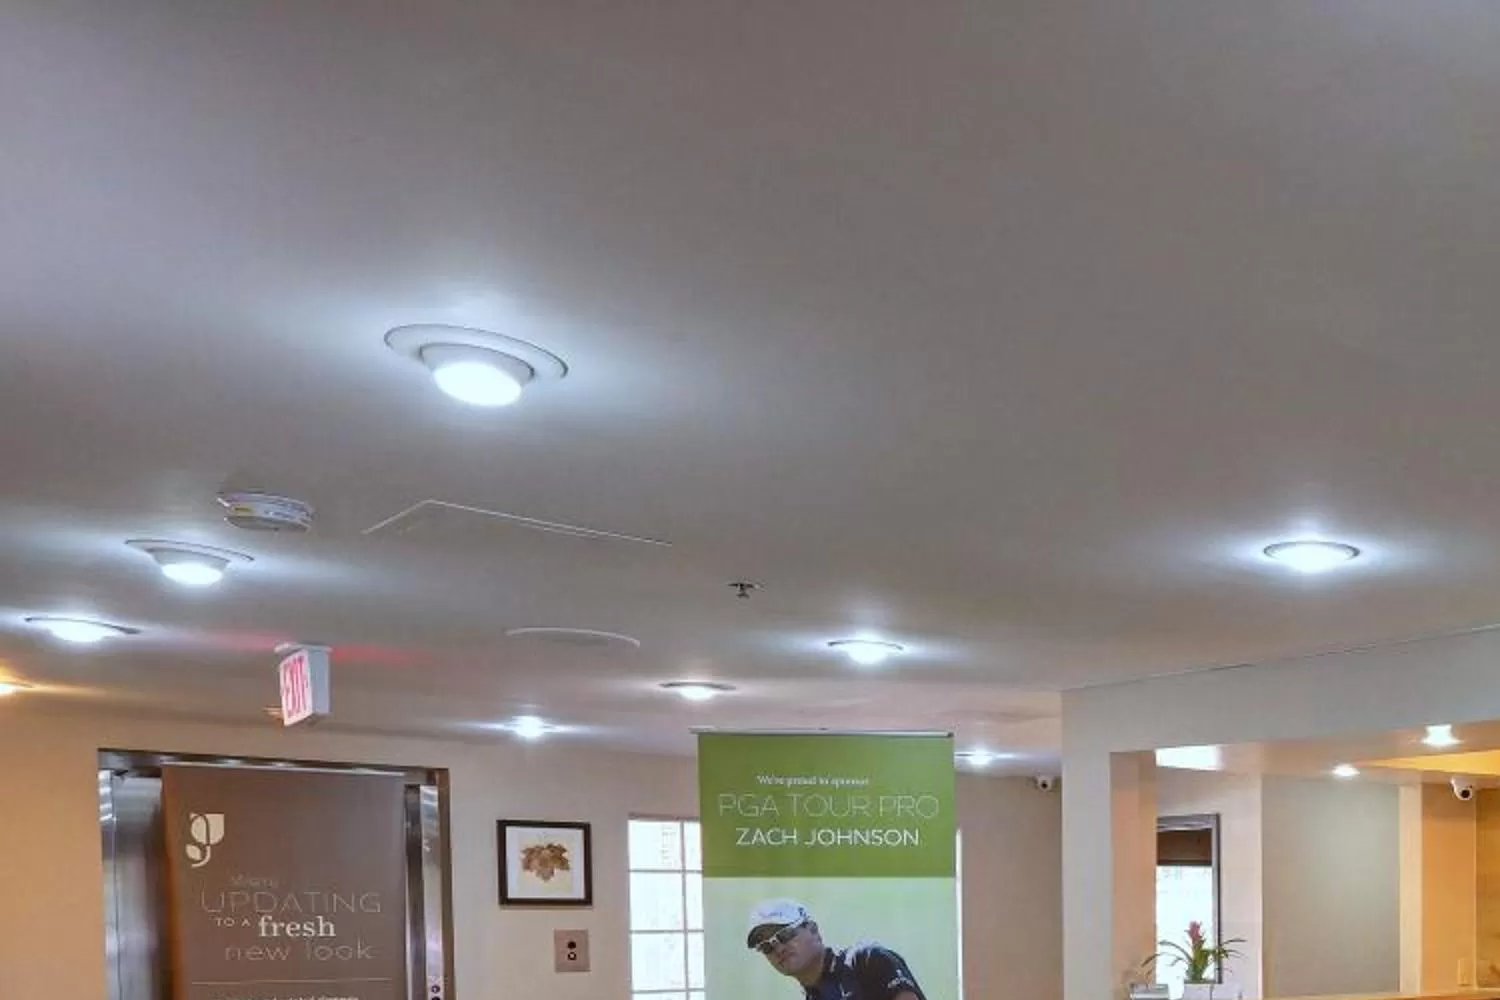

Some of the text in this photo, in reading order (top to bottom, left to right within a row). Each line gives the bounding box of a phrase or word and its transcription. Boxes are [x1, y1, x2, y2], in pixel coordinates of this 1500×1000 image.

[718, 793, 940, 818] PGA TOUR PRO
[735, 827, 920, 847] ZACH JOHNSON
[201, 891, 382, 913] UPDATING
[215, 915, 337, 937] TO A fresh
[224, 936, 375, 961] new look
